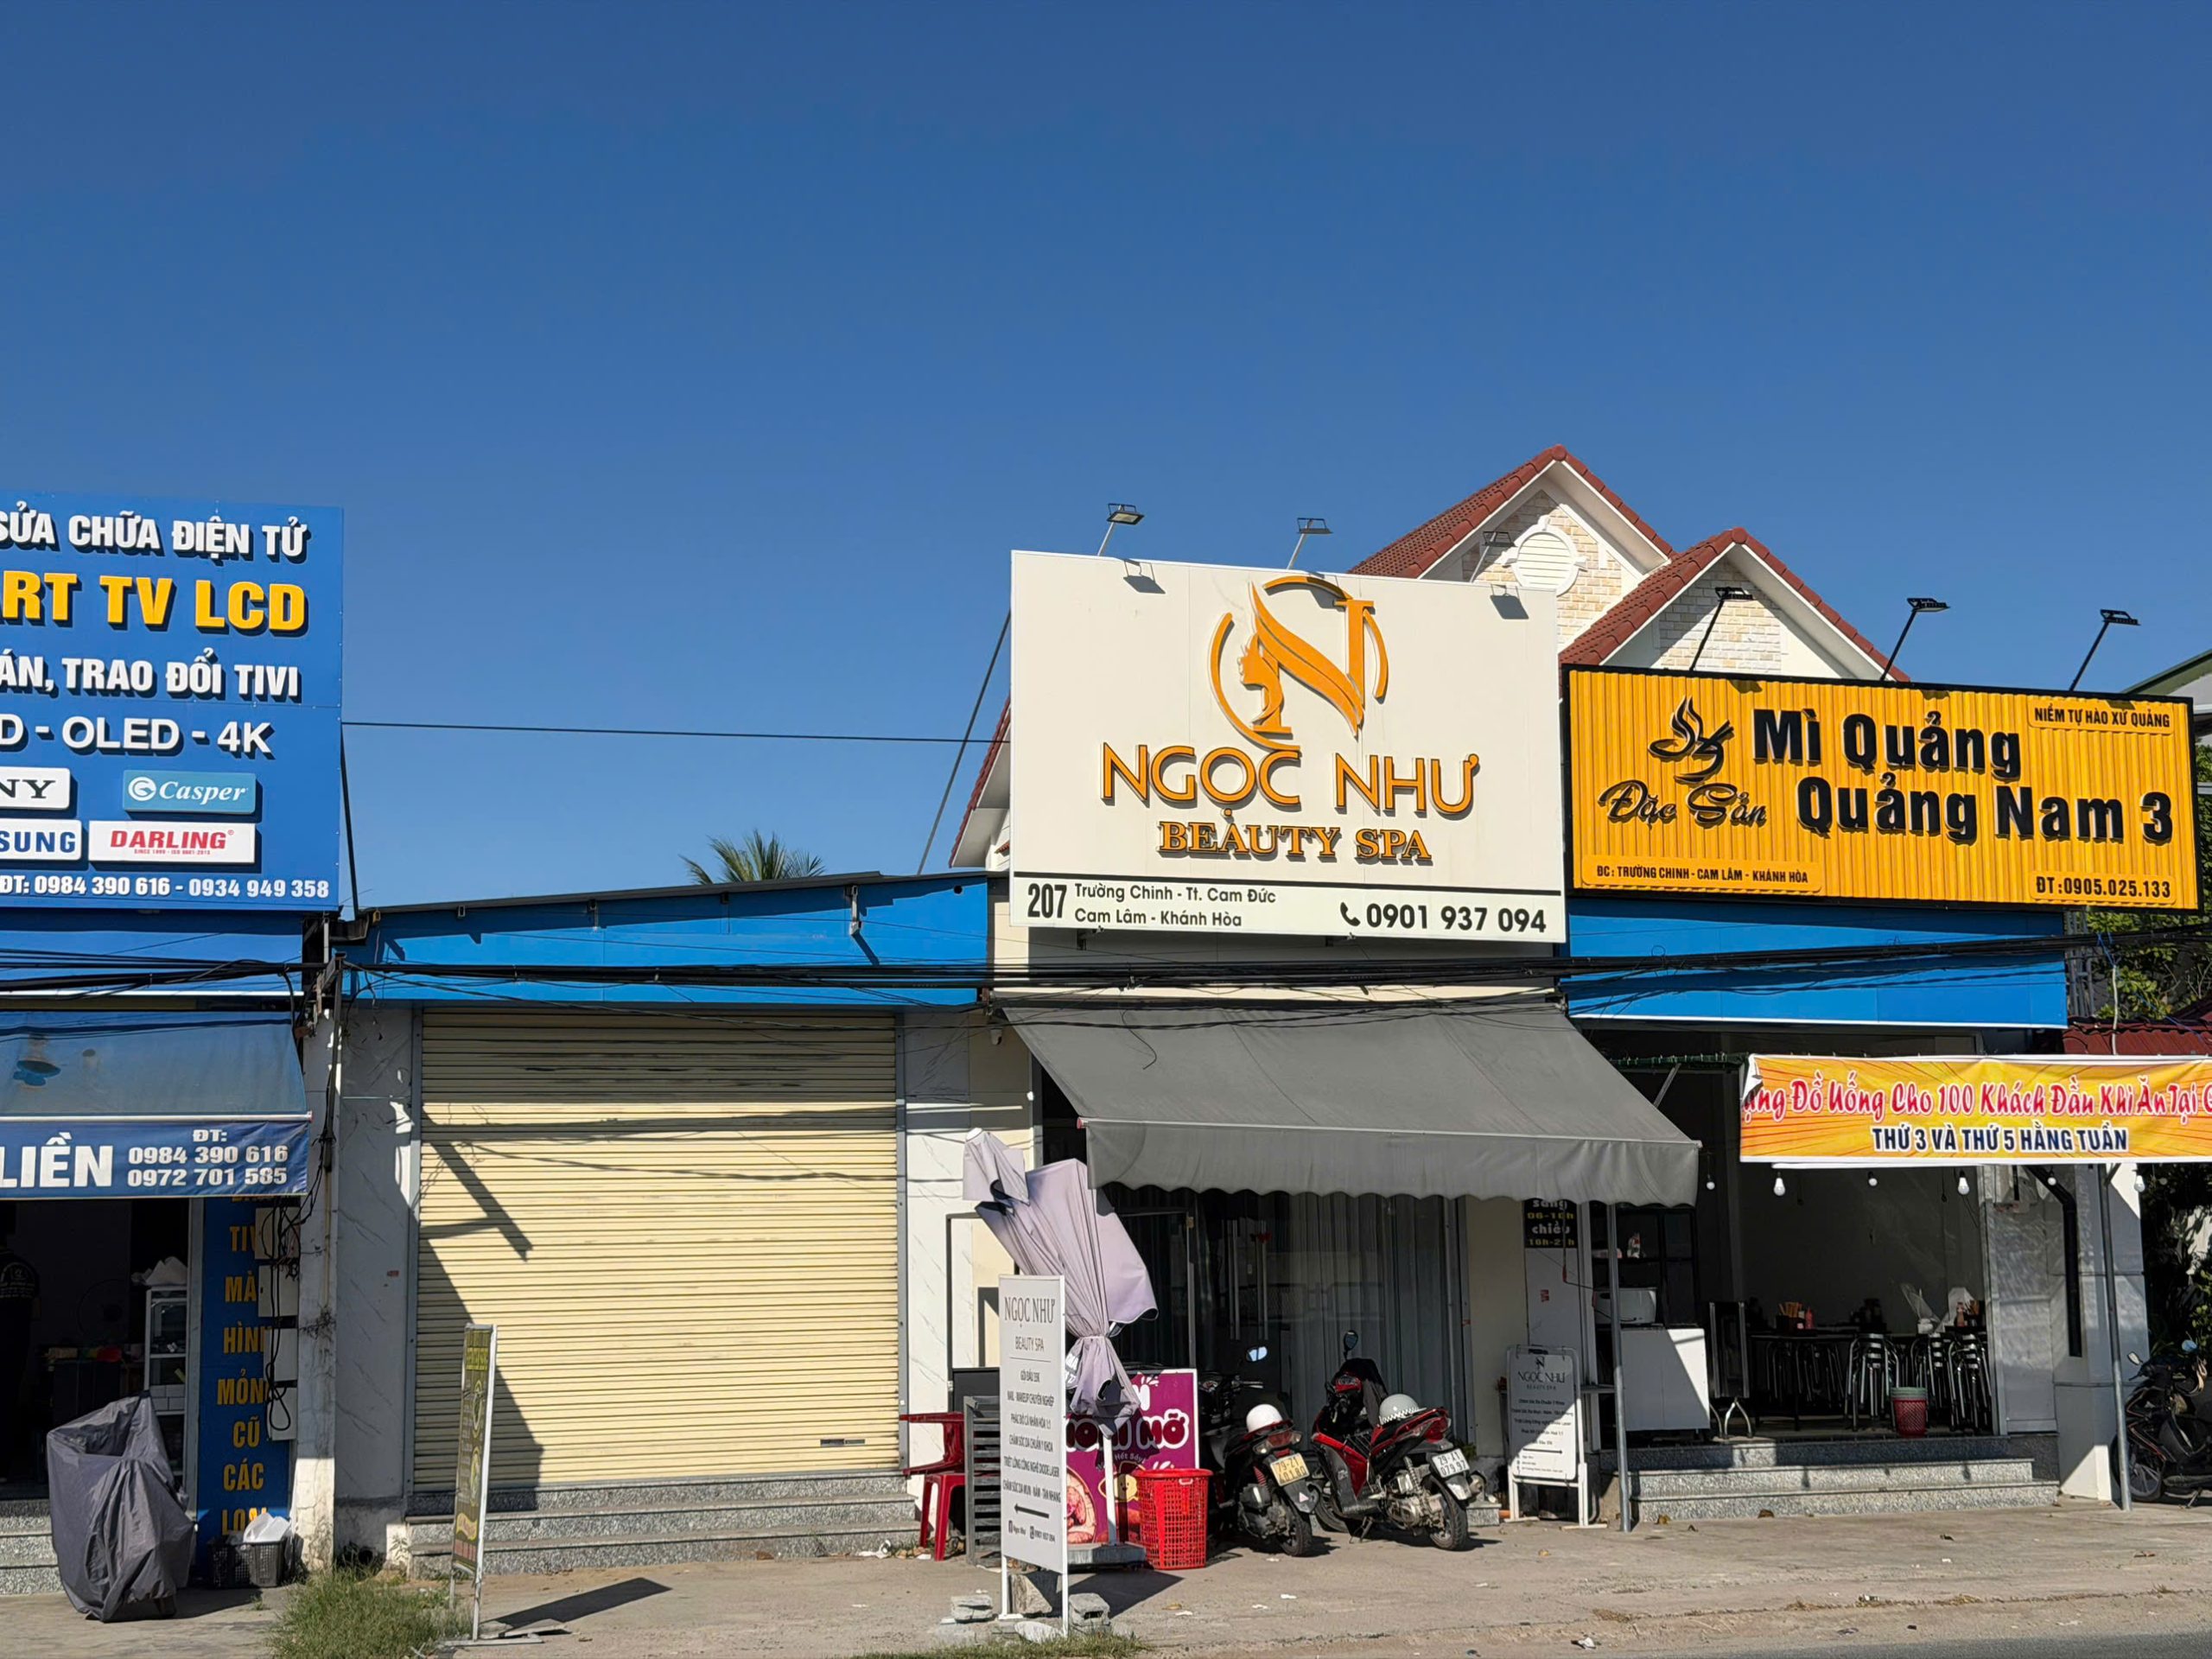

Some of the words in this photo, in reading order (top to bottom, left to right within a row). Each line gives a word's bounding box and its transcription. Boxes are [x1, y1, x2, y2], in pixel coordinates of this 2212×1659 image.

[68, 510, 161, 550] CHỮA
[171, 516, 250, 559] ĐIỆN
[262, 516, 308, 557] TỬ
[99, 575, 173, 625] TV
[195, 579, 305, 631] LCD
[61, 658, 154, 692] TRAO
[165, 647, 222, 694] ĐỔI
[234, 664, 299, 696] TIVI
[2068, 709, 2082, 726] TỰ
[2085, 708, 2108, 724] HÀO
[2131, 709, 2170, 728] QUẢNG
[62, 716, 180, 749] OLED
[217, 721, 272, 753] 4K
[1752, 709, 1821, 763] Mì
[1842, 710, 2021, 780] Quảng
[159, 781, 247, 805] Casper
[1101, 741, 1301, 817] NGỌC
[1334, 752, 1480, 816] NHƯ
[1598, 779, 1677, 830] Đặc
[1687, 783, 1767, 827] Sản
[1797, 772, 1977, 842] Quảng
[1993, 785, 2124, 842] Nam
[2140, 791, 2173, 843] 3
[111, 830, 226, 849] DARLING
[1159, 820, 1341, 857] BEAUTY
[1355, 828, 1433, 861] SPA
[35, 875, 86, 894] 0984
[92, 876, 130, 895] 390
[135, 877, 170, 896] 616
[188, 878, 240, 897] 0934
[246, 880, 286, 898] 949
[291, 880, 329, 899] 358
[1617, 865, 1656, 879] TRƯỜNG
[1659, 868, 1689, 880] CHINH
[1697, 868, 1719, 880] CAM
[1721, 868, 1743, 880] LÂM
[1752, 868, 1786, 882] KHÁNH
[1789, 869, 1808, 883] HÒA
[1027, 883, 1067, 918] 207
[1075, 883, 1124, 901] Trường
[1130, 885, 1173, 900] Chinh
[1208, 888, 1243, 902] Cam
[1248, 888, 1276, 903] Đức
[1075, 908, 1110, 923] Cam
[1116, 909, 1146, 924] Lâm
[1160, 910, 1207, 925] Khánh
[1212, 912, 1242, 926] Hòa
[1366, 903, 1427, 929] 0901
[1440, 906, 1487, 931] 937
[1498, 908, 1547, 932] 094
[1790, 1071, 1822, 1113] Đồ
[1828, 1071, 1885, 1122] Uống
[1891, 1082, 1932, 1115] Cho
[1938, 1084, 1974, 1115] 100
[1980, 1079, 2045, 1116] Khách
[2100, 1084, 2133, 1116] Khi
[2137, 1076, 2166, 1116] Ăn
[2168, 1084, 2198, 1124] Tại
[193, 1129, 227, 1142] ĐT:
[1872, 1124, 1910, 1150] THỨ
[1916, 1129, 1927, 1150] 3
[1931, 1124, 1956, 1150] VÀ
[1961, 1124, 1999, 1150] THỨ
[2004, 1130, 2014, 1150] 5
[129, 1147, 188, 1164] 0984
[194, 1146, 238, 1163] 390
[245, 1145, 289, 1163] 616
[127, 1169, 188, 1186] 0972
[194, 1168, 235, 1185] 701
[245, 1167, 288, 1185] 585
[1004, 1297, 1030, 1327] NGỌC
[1033, 1298, 1056, 1324] NHƯ
[223, 1459, 264, 1491] CÁC
